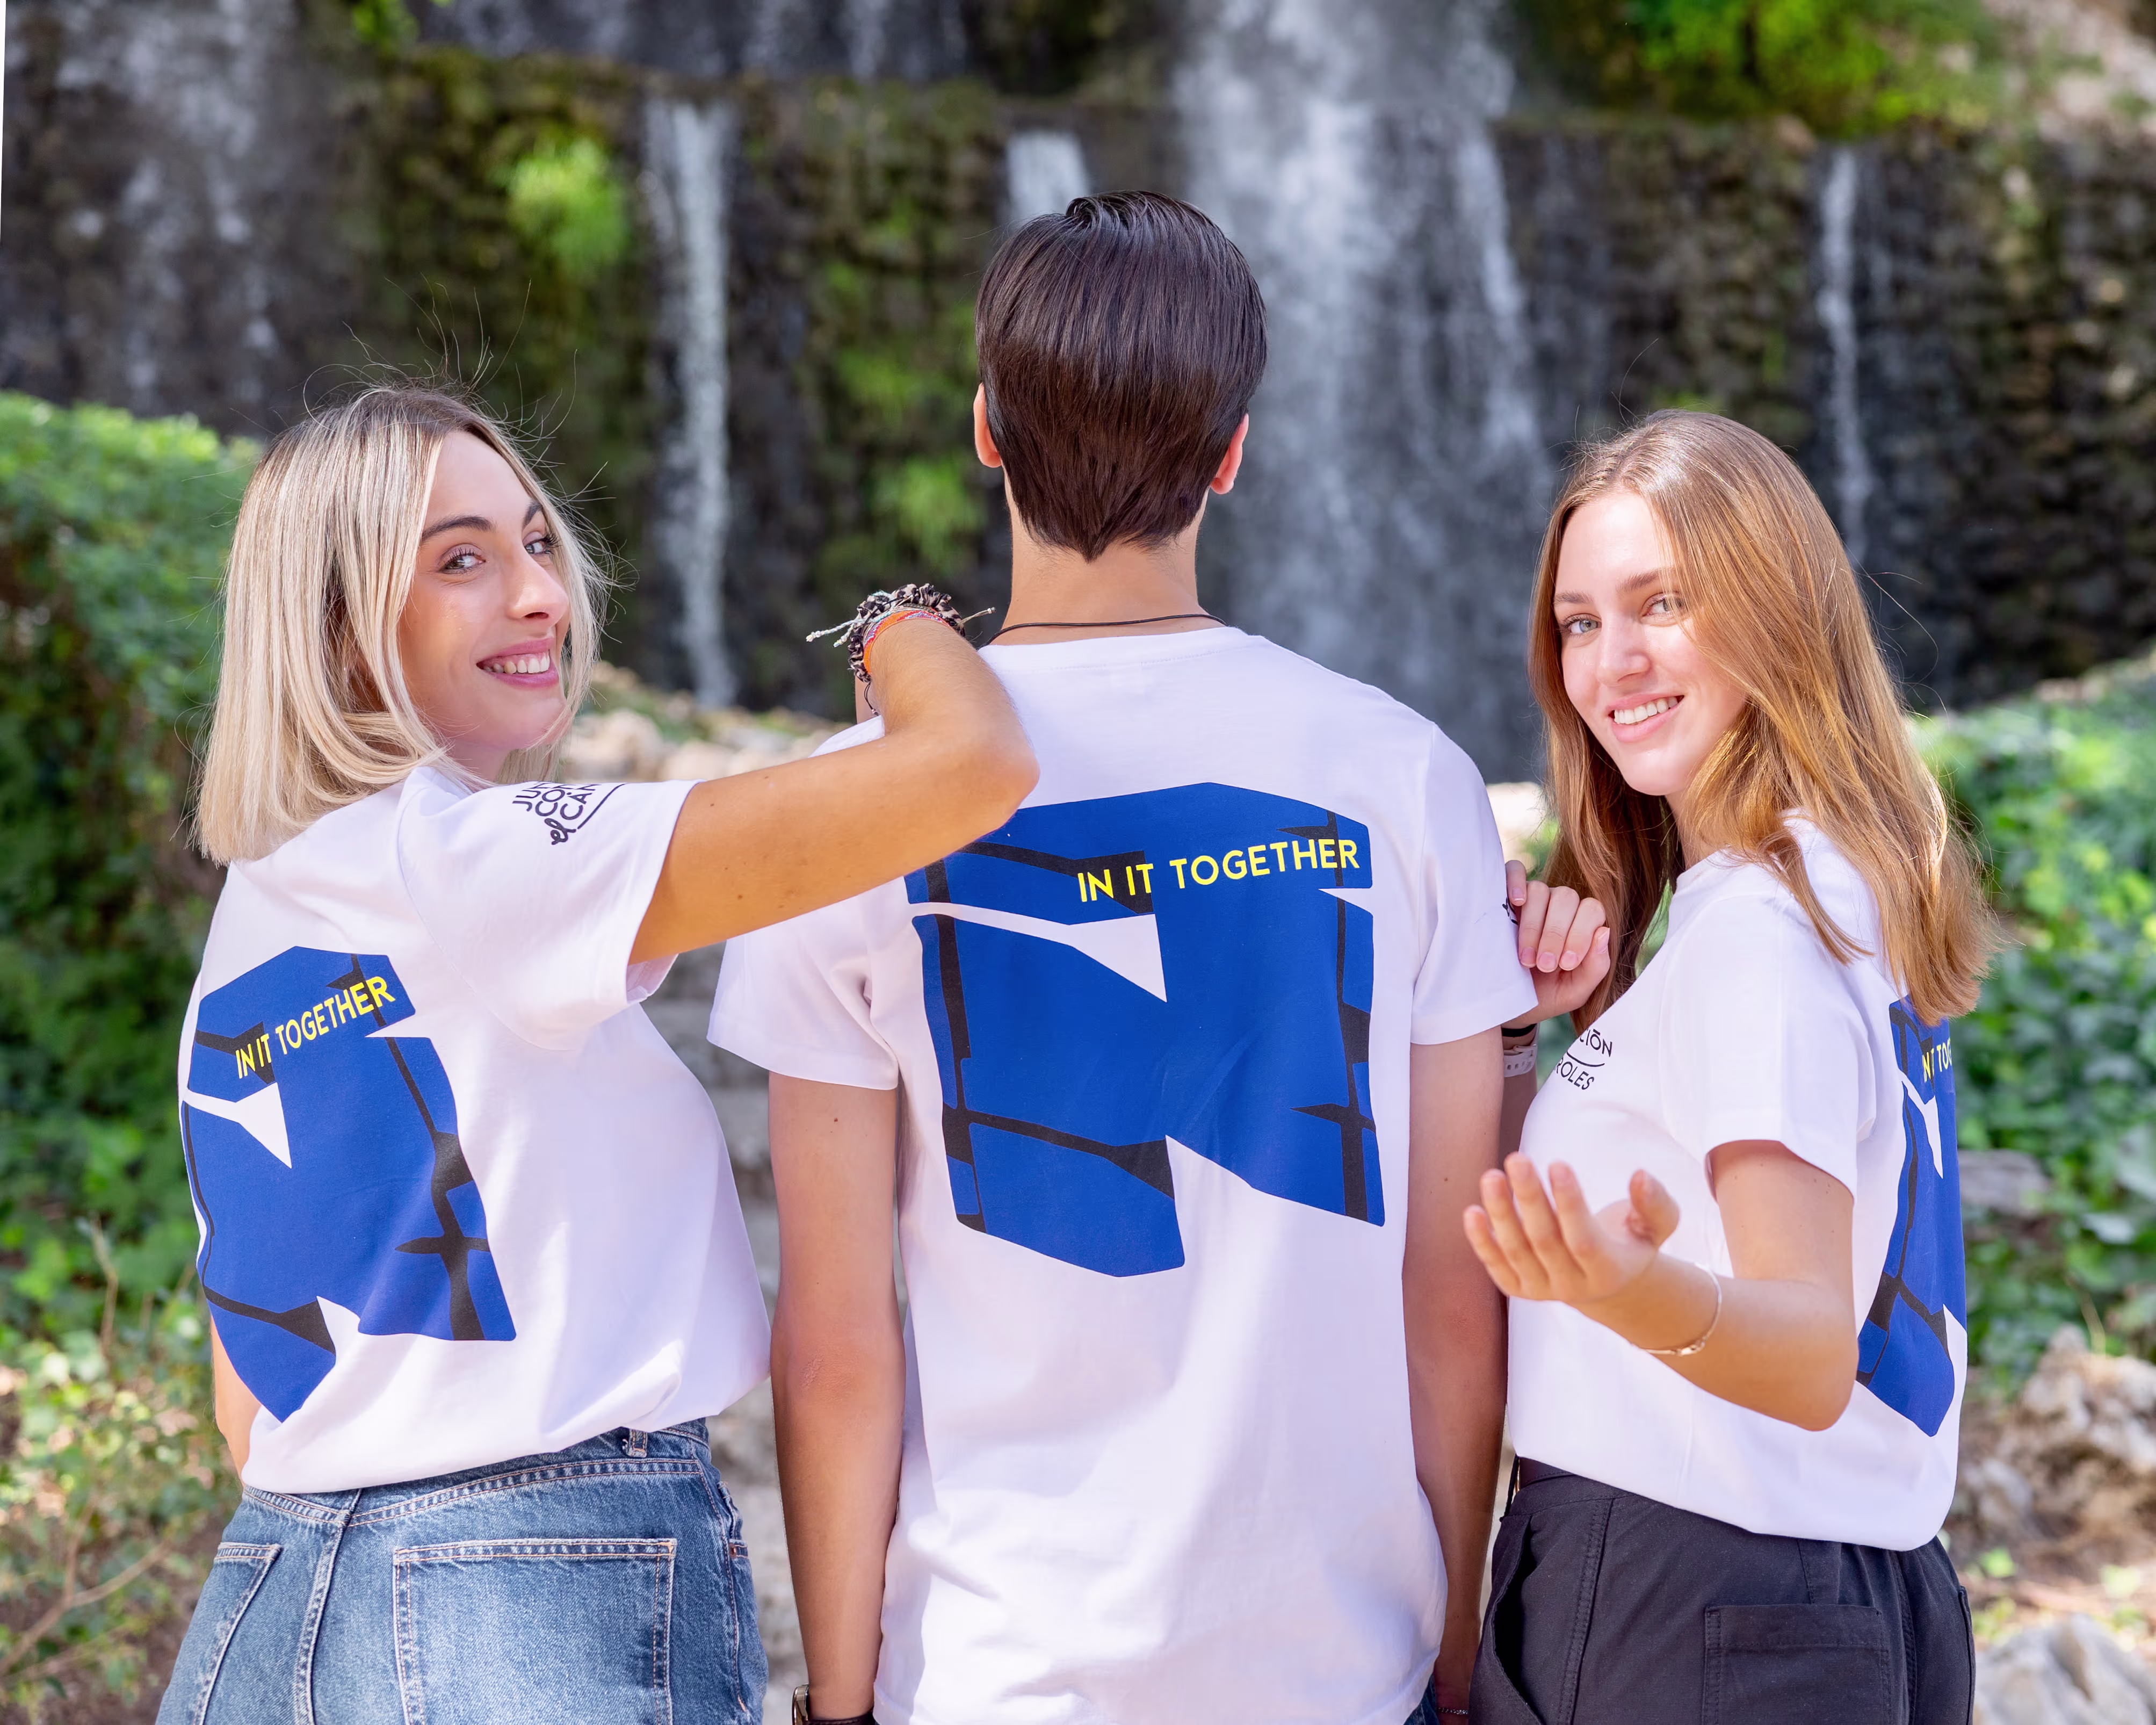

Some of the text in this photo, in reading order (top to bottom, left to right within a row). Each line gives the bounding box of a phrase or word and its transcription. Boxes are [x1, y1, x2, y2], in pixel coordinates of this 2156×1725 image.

[1077, 839, 1360, 903] IN IT TOGETHER
[235, 976, 396, 1079] IN IT TOGETHER
